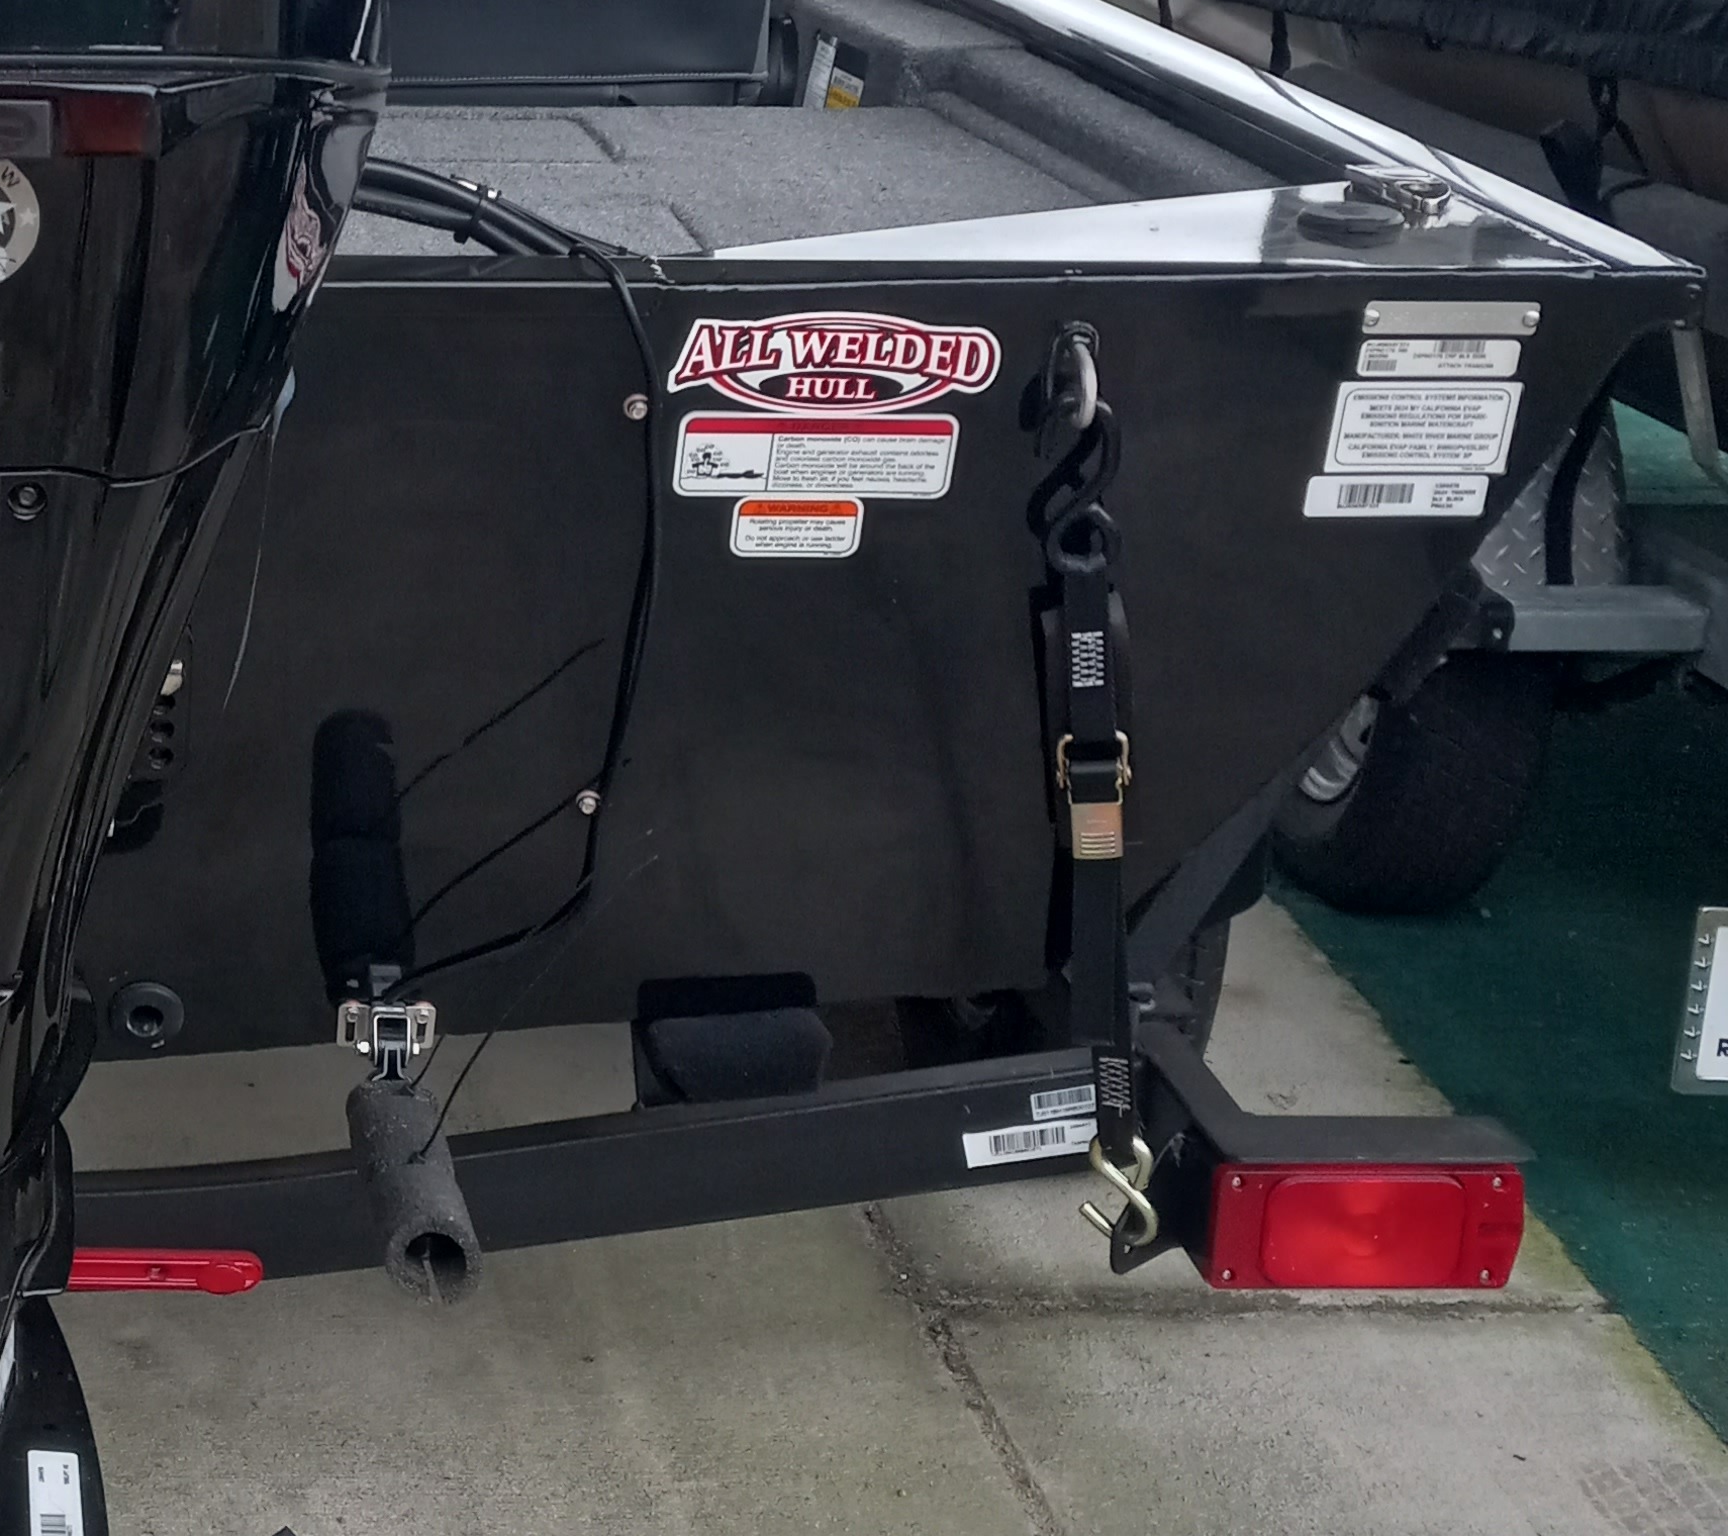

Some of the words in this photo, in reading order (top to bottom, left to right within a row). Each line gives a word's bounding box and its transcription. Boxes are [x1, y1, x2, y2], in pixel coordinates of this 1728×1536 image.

[677, 326, 785, 380] ALL
[790, 329, 990, 384] WELDED
[785, 375, 876, 400] HULL
[767, 503, 829, 513] WARNING
